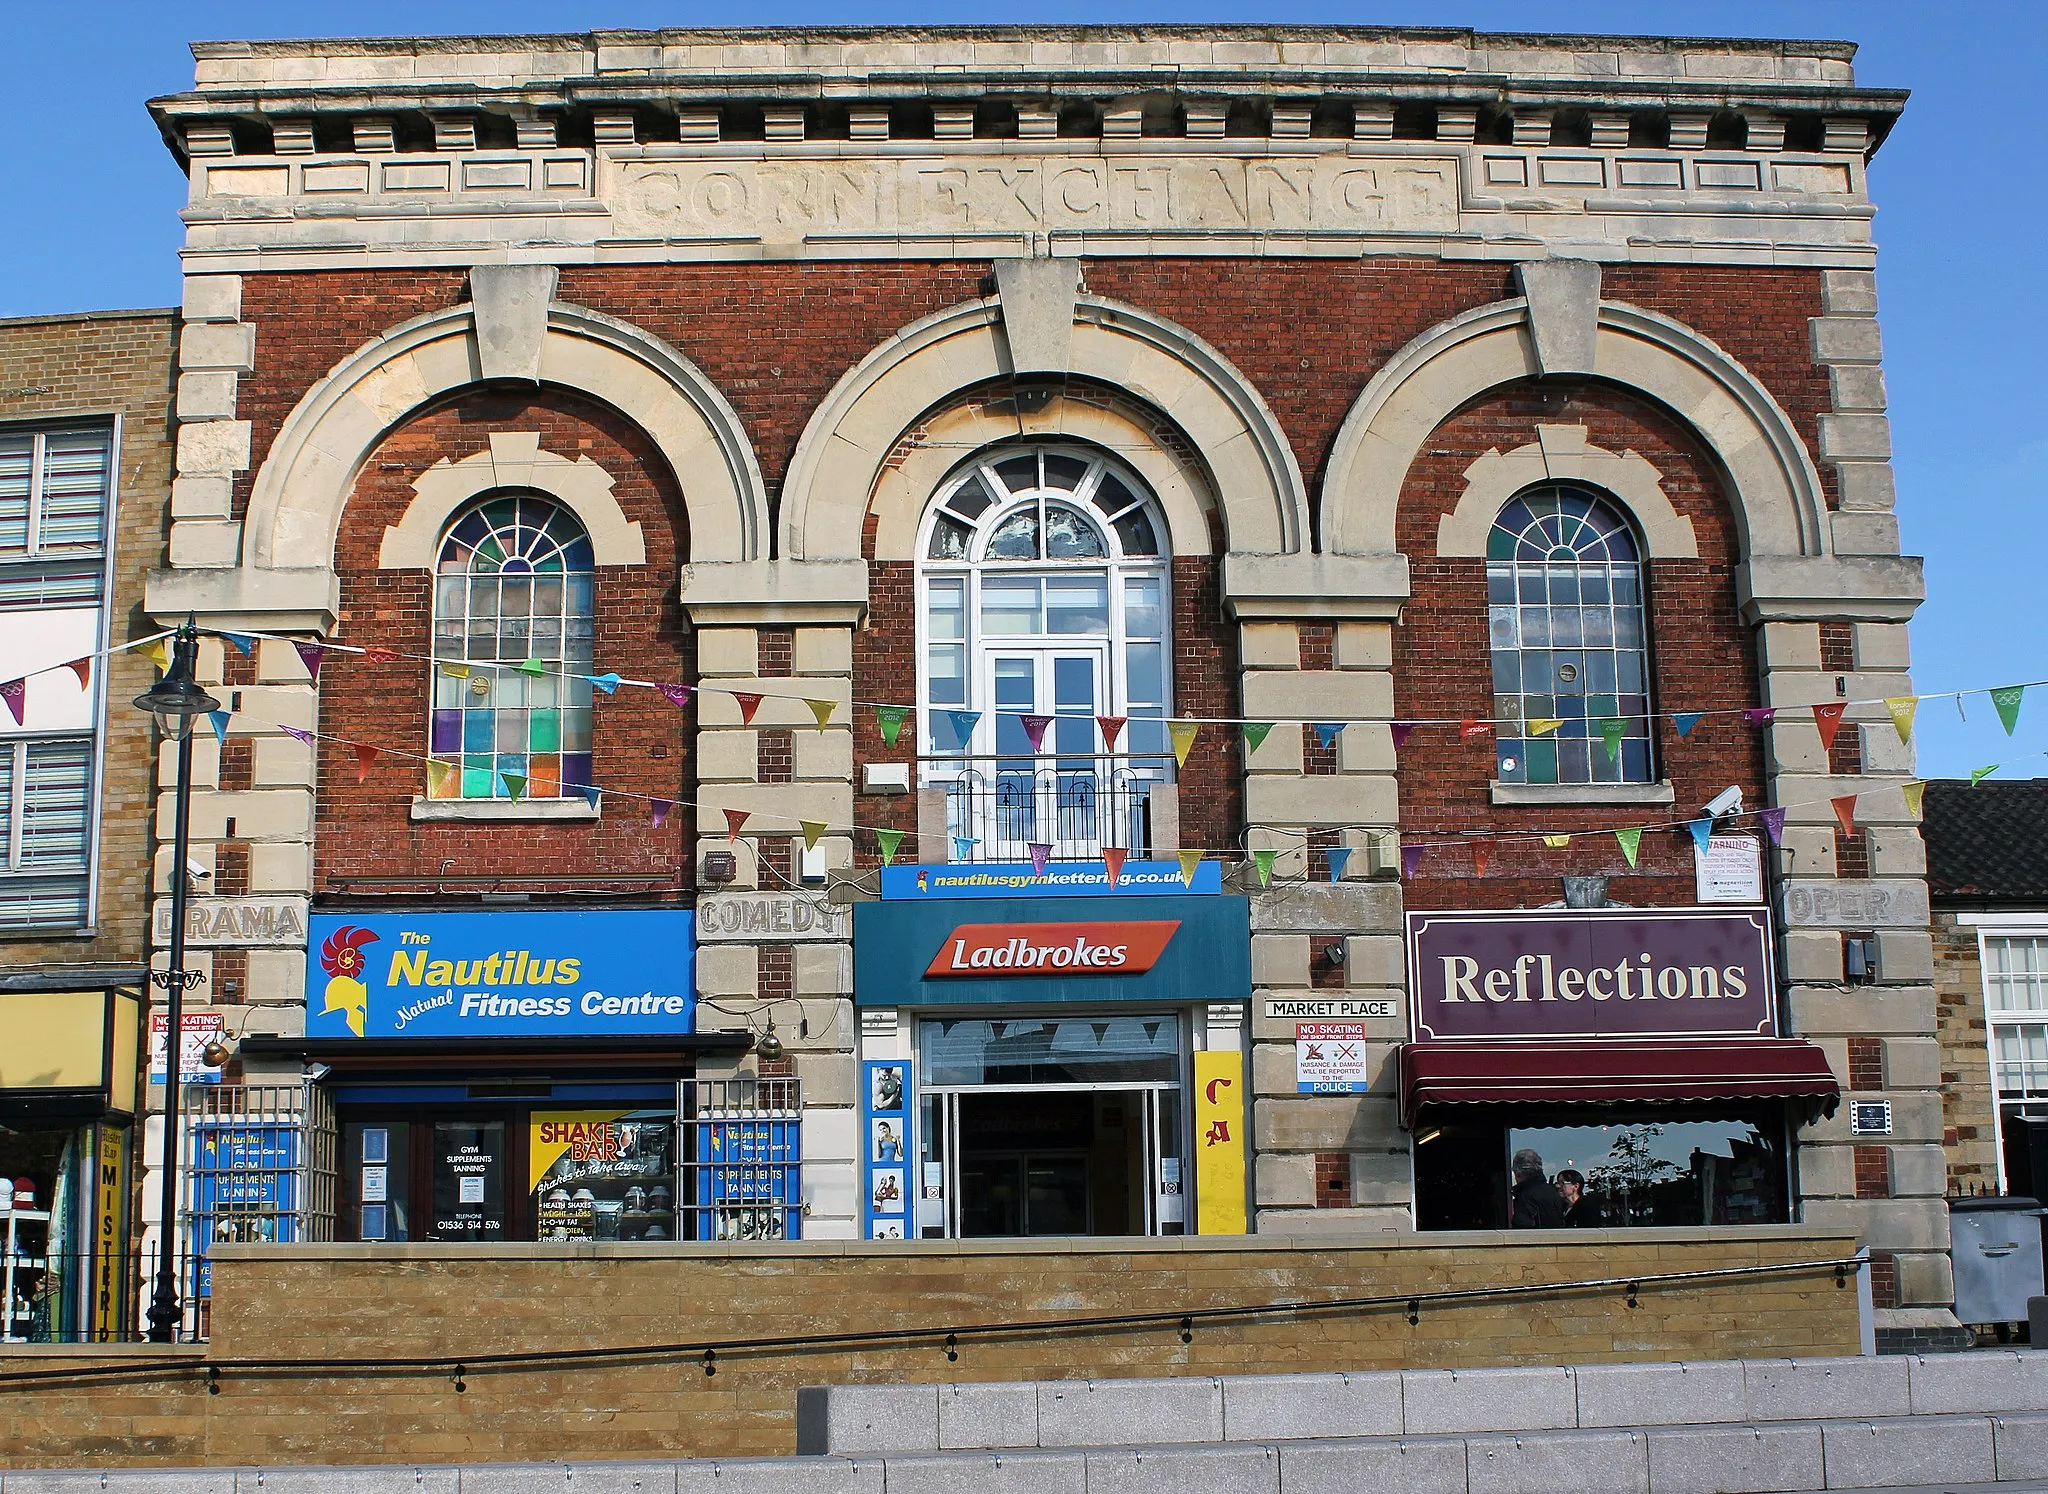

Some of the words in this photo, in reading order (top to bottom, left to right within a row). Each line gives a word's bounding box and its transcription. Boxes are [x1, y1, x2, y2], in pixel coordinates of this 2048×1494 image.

[626, 168, 882, 228] CORN
[918, 166, 1448, 228] EXCHANGE
[1889, 701, 1914, 709] London
[1895, 708, 1910, 716] 2012
[934, 871, 1186, 888] nautilusgymketterig.co.uk
[700, 900, 842, 933] COMEDY
[400, 931, 431, 945] The
[951, 936, 1128, 970] Ladbrokes
[387, 950, 582, 987] Nautilus
[1437, 952, 1748, 1003] Reflections
[394, 988, 454, 1030] Natural
[459, 992, 572, 1018] Fitness
[580, 990, 685, 1016] Centre
[1273, 1002, 1335, 1015] MARKET
[1341, 1002, 1389, 1015] PLACE
[181, 1015, 219, 1025] KATING
[1300, 1025, 1316, 1034] NO
[1319, 1024, 1363, 1034] SKATING
[179, 1073, 206, 1083] LICE
[1313, 1082, 1353, 1092] POLICE
[539, 1121, 615, 1144] SHAKE
[727, 1130, 769, 1139] Nautius
[460, 1146, 479, 1154] GYM
[571, 1140, 618, 1162] BAR
[446, 1155, 492, 1163] SUPPLEMENTS
[453, 1164, 486, 1172] TANNING
[537, 1171, 573, 1195] Shakes
[574, 1165, 587, 1178] to
[614, 1160, 648, 1173] Away
[728, 1183, 772, 1193] TANNNG
[542, 1210, 567, 1218] WEIGHT
[575, 1210, 592, 1218] LOSS
[437, 1220, 464, 1230] 01536
[467, 1220, 482, 1229] 514
[484, 1220, 501, 1229] 576
[542, 1218, 566, 1226] L-O-W
[566, 1218, 578, 1226] FAT
[99, 1164, 117, 1312] MISTER
